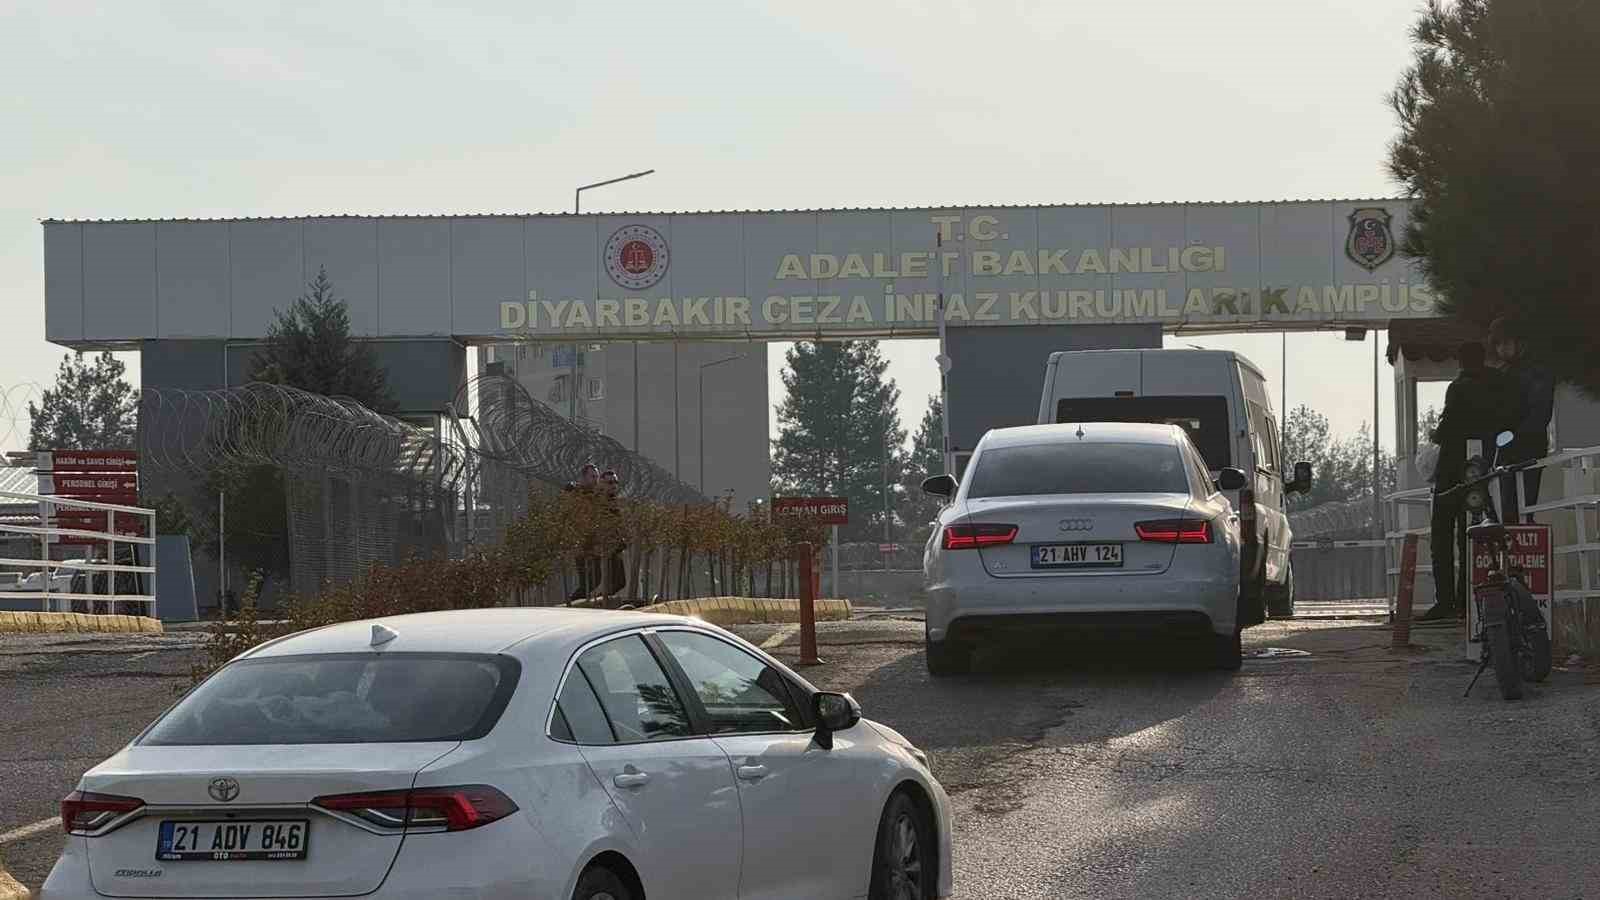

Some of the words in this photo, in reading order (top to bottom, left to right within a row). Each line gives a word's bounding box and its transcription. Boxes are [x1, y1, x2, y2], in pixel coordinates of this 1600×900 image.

[930, 214, 1009, 242] T.C.
[775, 251, 960, 280] ADALET
[972, 239, 1226, 276] BAKANLIĞI
[500, 290, 751, 329] DİYARBAKIR
[761, 294, 873, 326] CEZA
[884, 283, 1001, 322] İNFAZ
[1008, 285, 1258, 321] KURUMLARI
[1040, 547, 1056, 562] 21
[1063, 546, 1089, 562] AHV
[1096, 546, 1119, 561] 124
[174, 826, 199, 851] 21
[212, 824, 251, 850] ADV
[261, 824, 301, 850] 846
